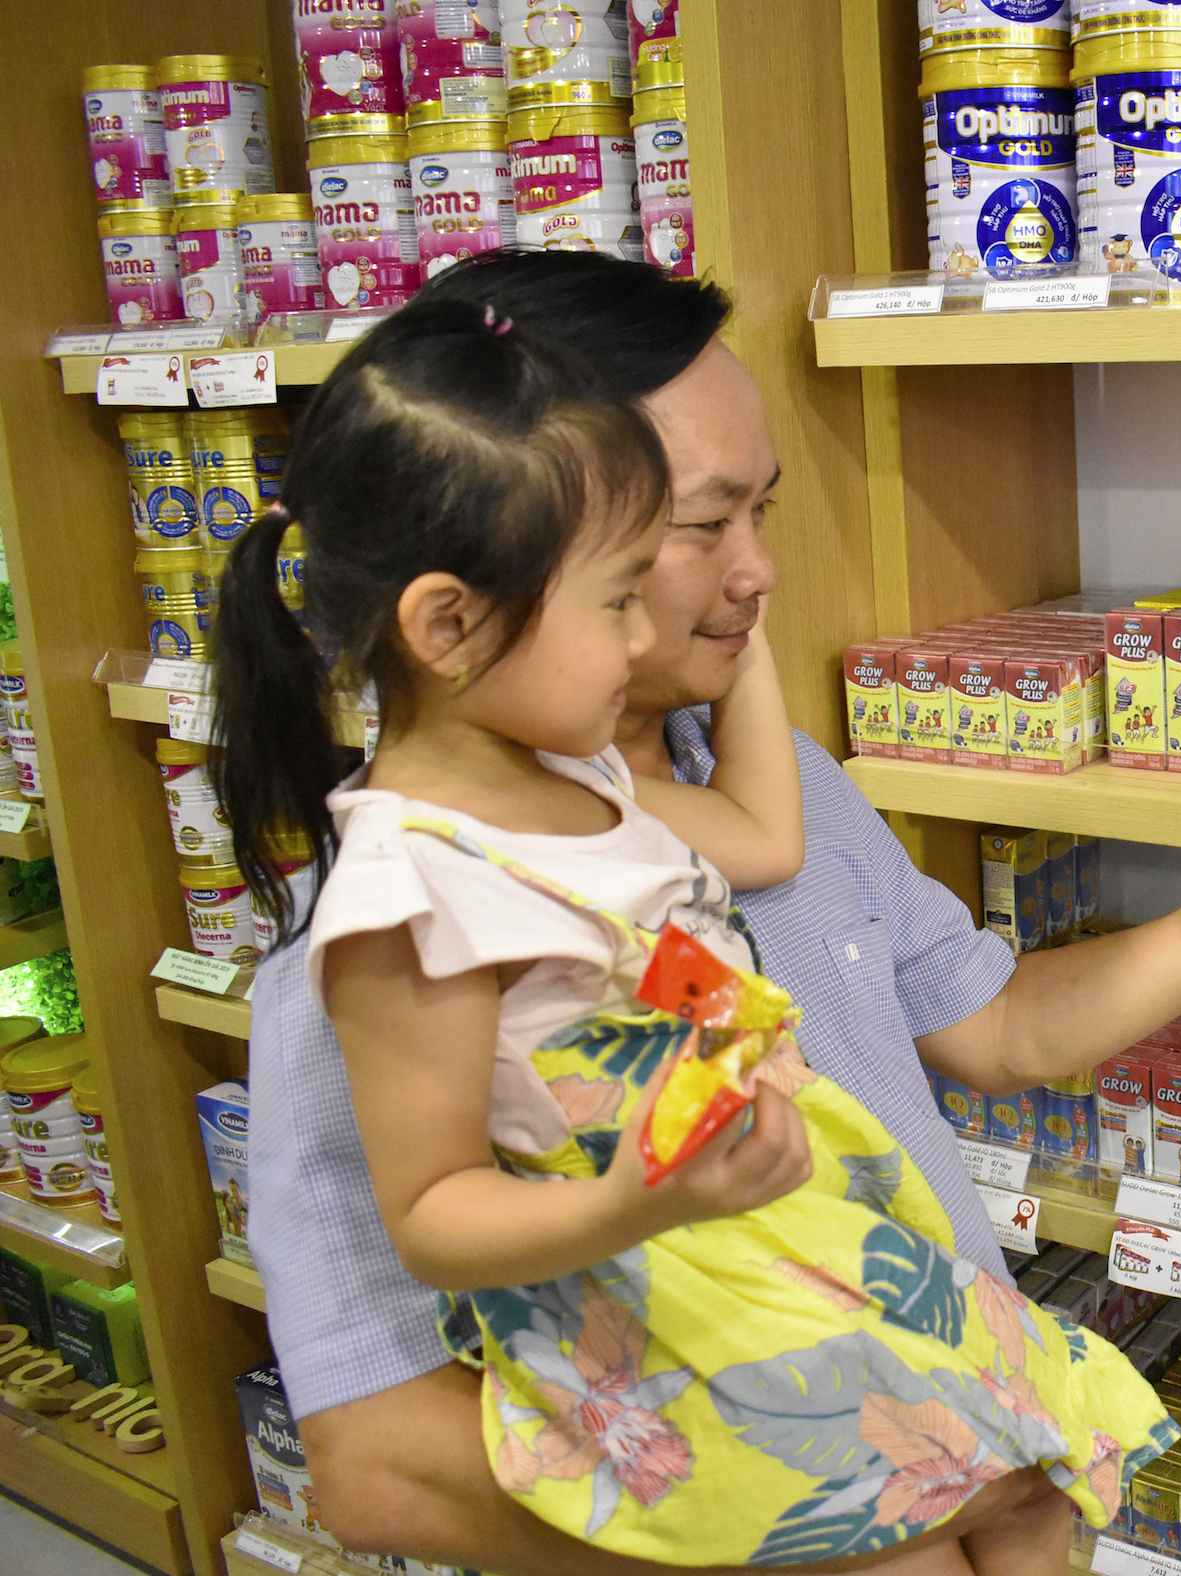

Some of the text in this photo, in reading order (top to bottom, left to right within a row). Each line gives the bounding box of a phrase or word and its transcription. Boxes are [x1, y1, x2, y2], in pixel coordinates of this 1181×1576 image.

[330, 16, 386, 30] GOLD
[999, 139, 1053, 156] GOLD
[421, 170, 446, 184] dielac
[320, 181, 346, 194] dielac
[432, 217, 483, 234] GOLD
[543, 214, 580, 236] GOLD
[331, 226, 383, 243] GOLD
[106, 256, 155, 276] mama
[1036, 295, 1065, 304] 421,630
[126, 446, 172, 468] Sure
[1113, 633, 1152, 648] GROW
[1120, 647, 1146, 659] PLUS
[854, 666, 883, 678] GROW
[859, 676, 879, 688] PLUS
[189, 906, 236, 930] Sure
[1101, 1075, 1143, 1095] GROW
[248, 1369, 279, 1388] Alpha
[257, 1420, 305, 1456] Alpha
